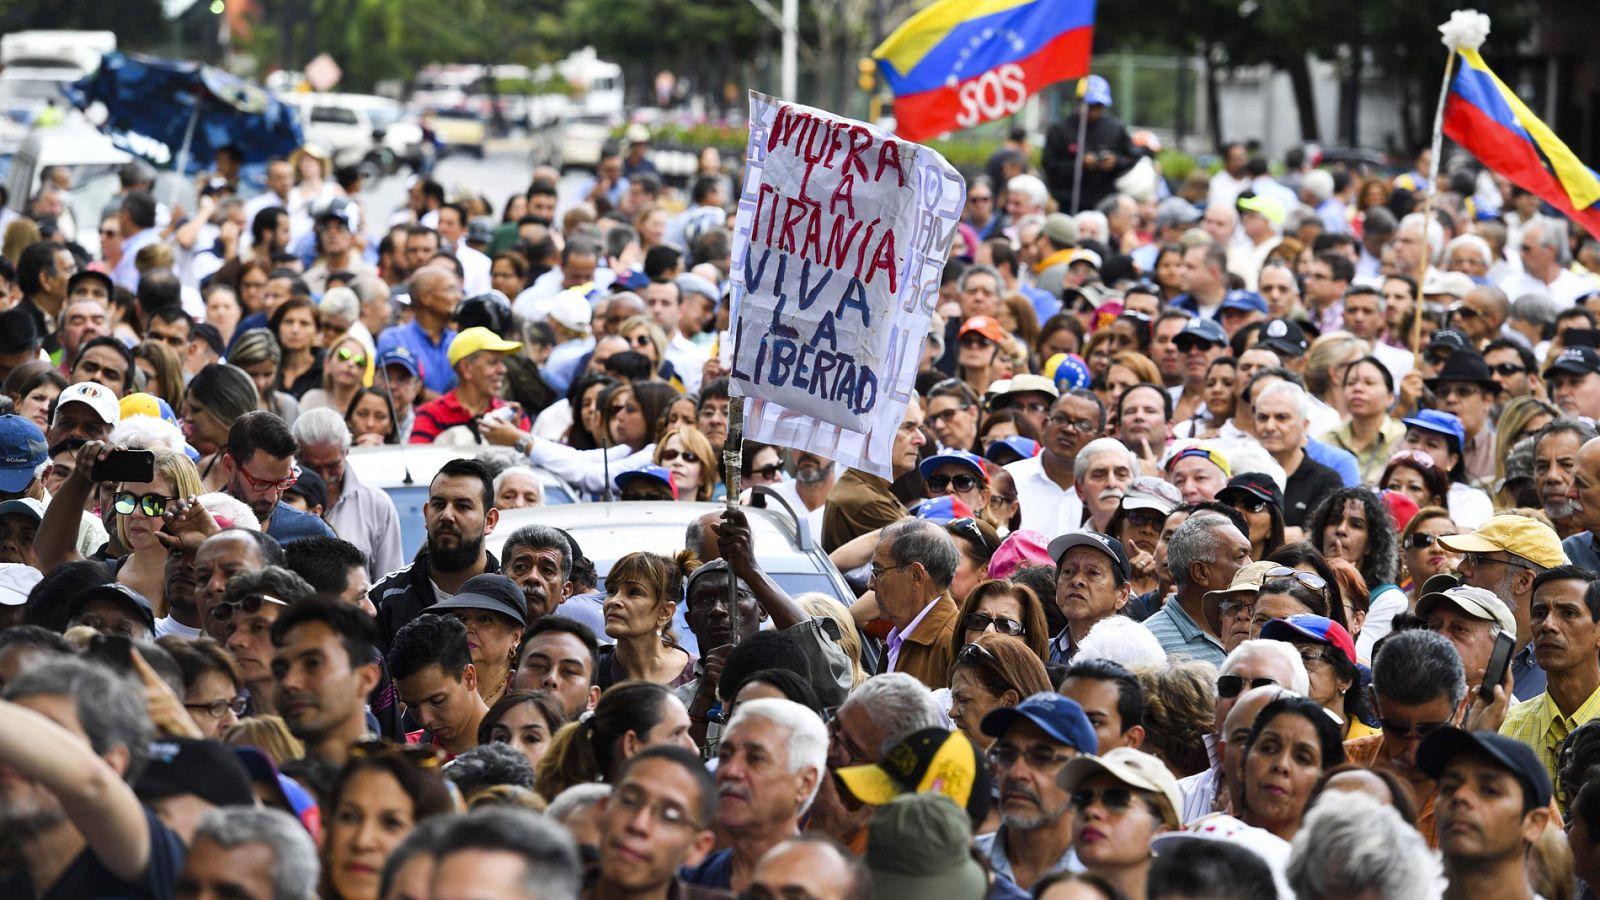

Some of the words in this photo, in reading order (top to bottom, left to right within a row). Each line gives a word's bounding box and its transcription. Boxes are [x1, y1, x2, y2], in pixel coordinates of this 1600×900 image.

[956, 63, 1027, 128] SOS
[768, 104, 905, 187] MUERA
[799, 161, 855, 220] LA
[751, 183, 896, 294] TIRANÍA
[769, 293, 837, 352] LA
